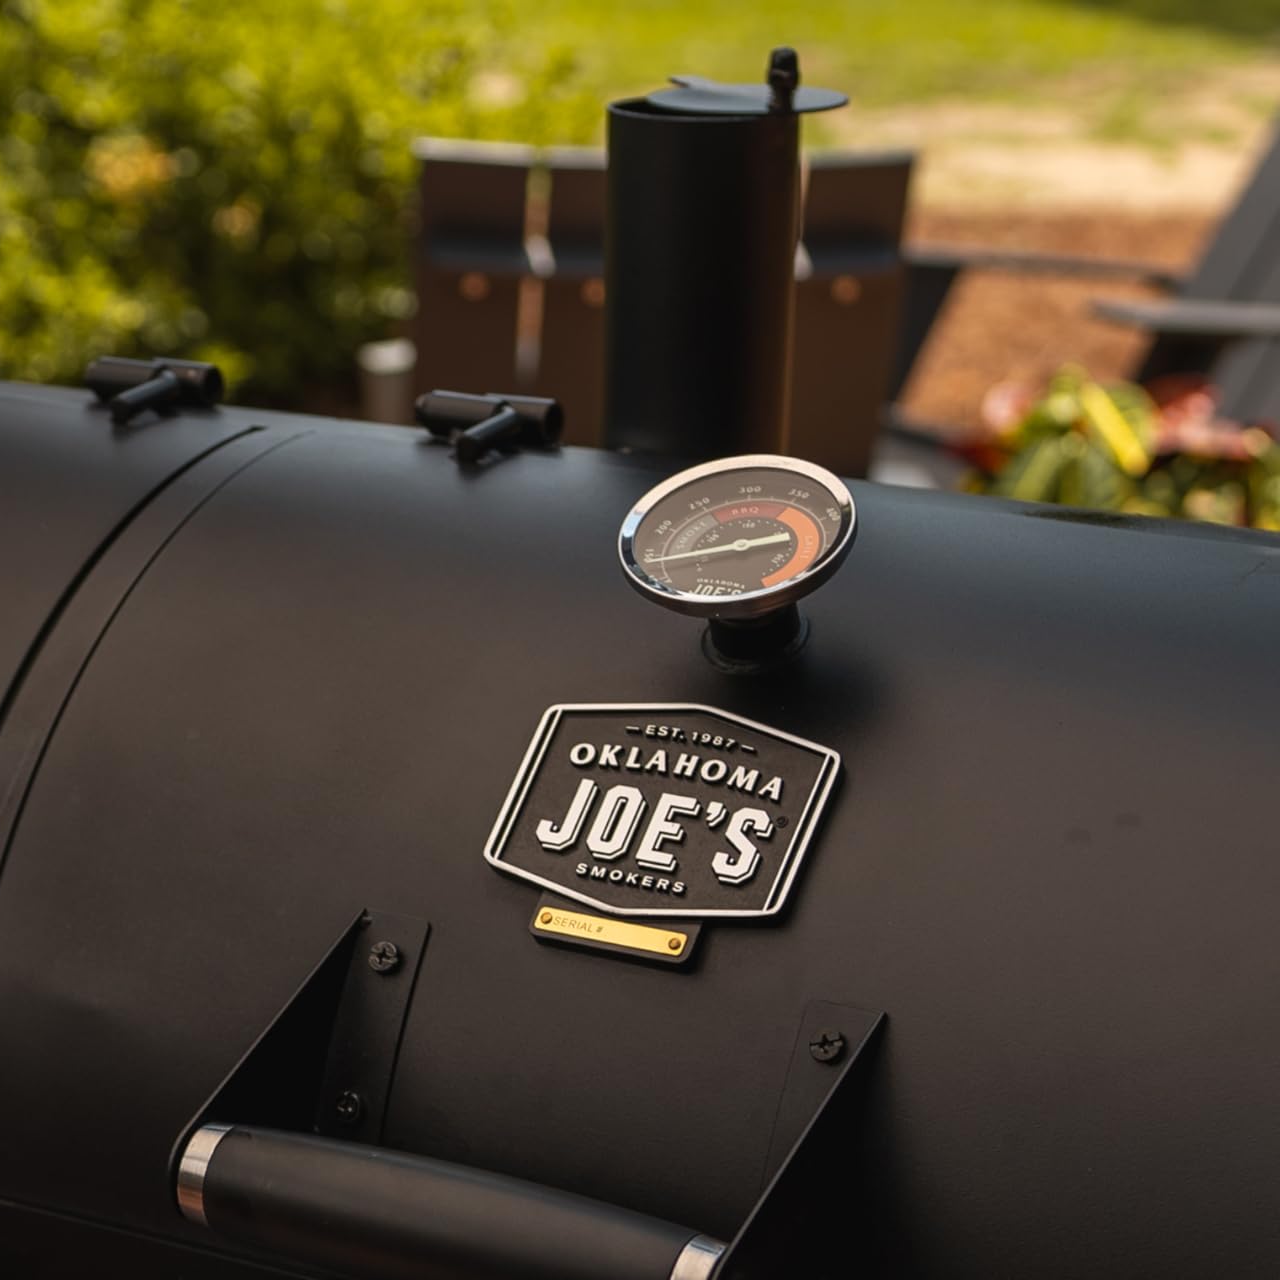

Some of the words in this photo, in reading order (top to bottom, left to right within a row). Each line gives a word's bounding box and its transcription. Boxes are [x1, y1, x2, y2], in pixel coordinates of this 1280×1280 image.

[738, 485, 762, 494] 300
[788, 488, 810, 499] 350
[644, 724, 684, 739] EST.
[691, 731, 736, 748] 1987
[569, 742, 784, 801] OKLAHOMA
[535, 777, 775, 885] JOE'S
[575, 862, 688, 894] SMOKERS
[552, 915, 594, 933] SERIAL
